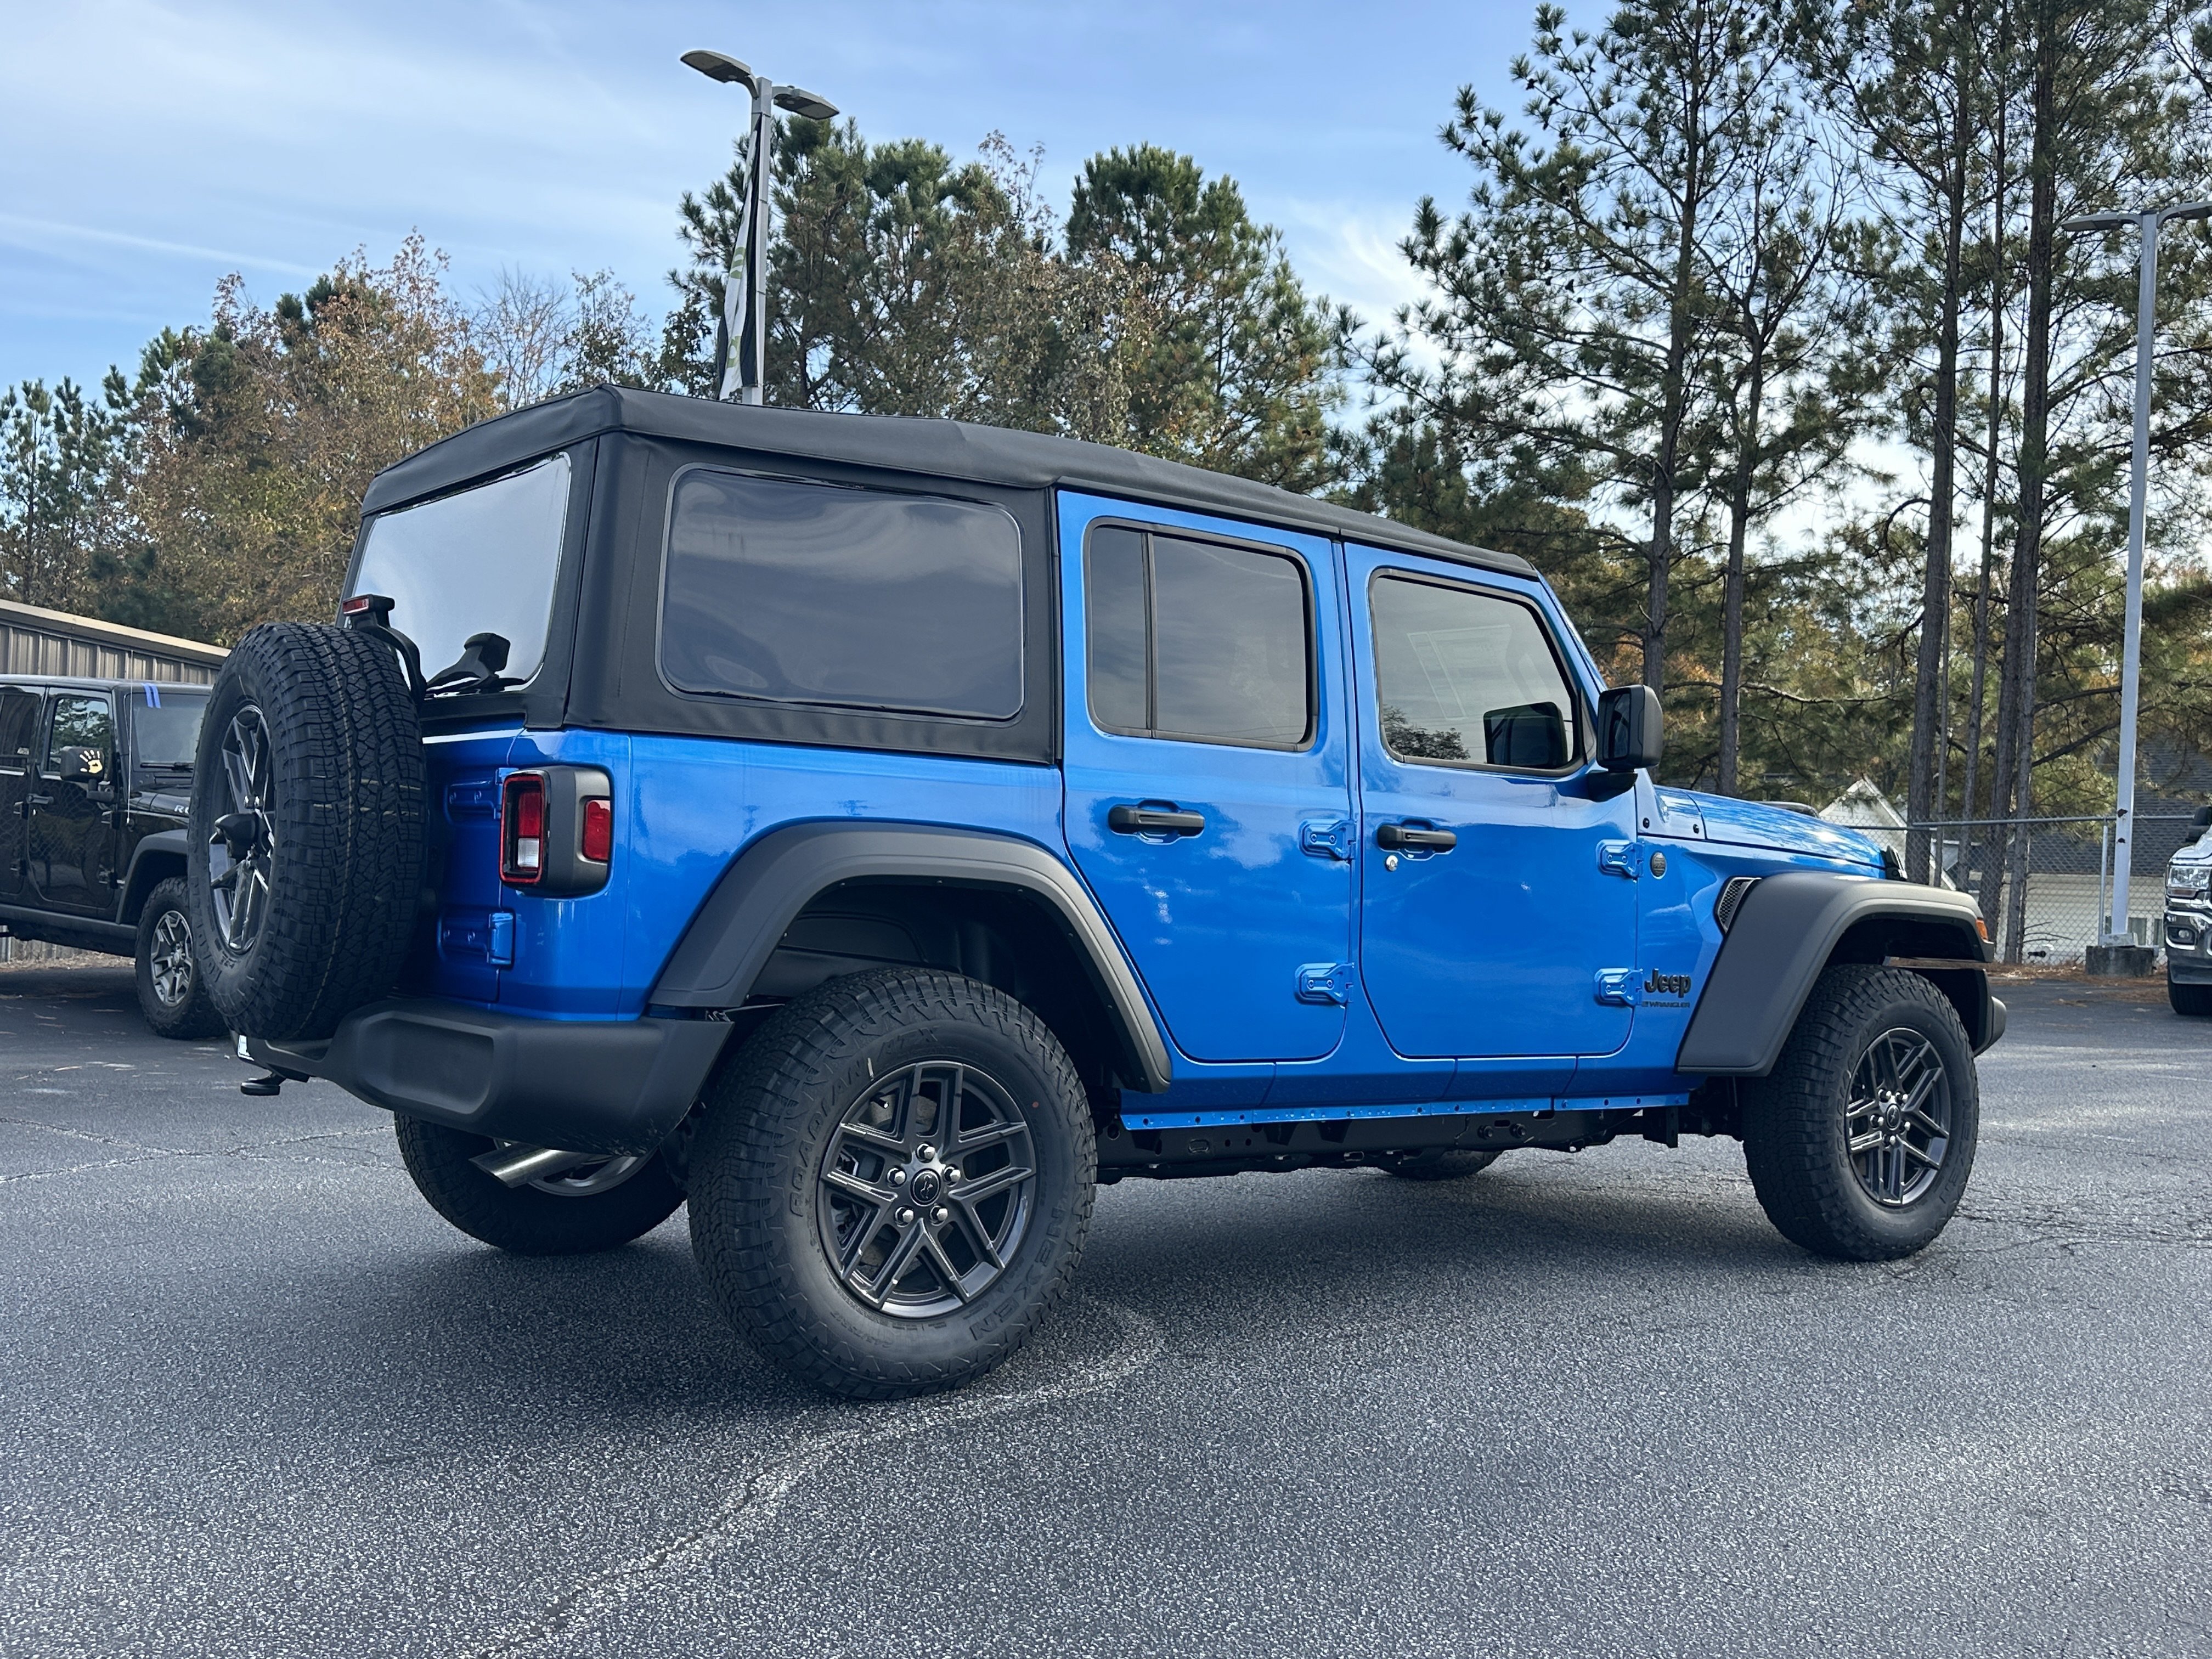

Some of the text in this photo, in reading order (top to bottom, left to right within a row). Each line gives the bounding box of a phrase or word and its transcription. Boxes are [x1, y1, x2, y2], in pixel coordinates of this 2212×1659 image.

[1644, 968, 1691, 998] Jeep
[1939, 1099, 1972, 1204] NEXEN
[969, 1201, 1068, 1341] NEXEN
